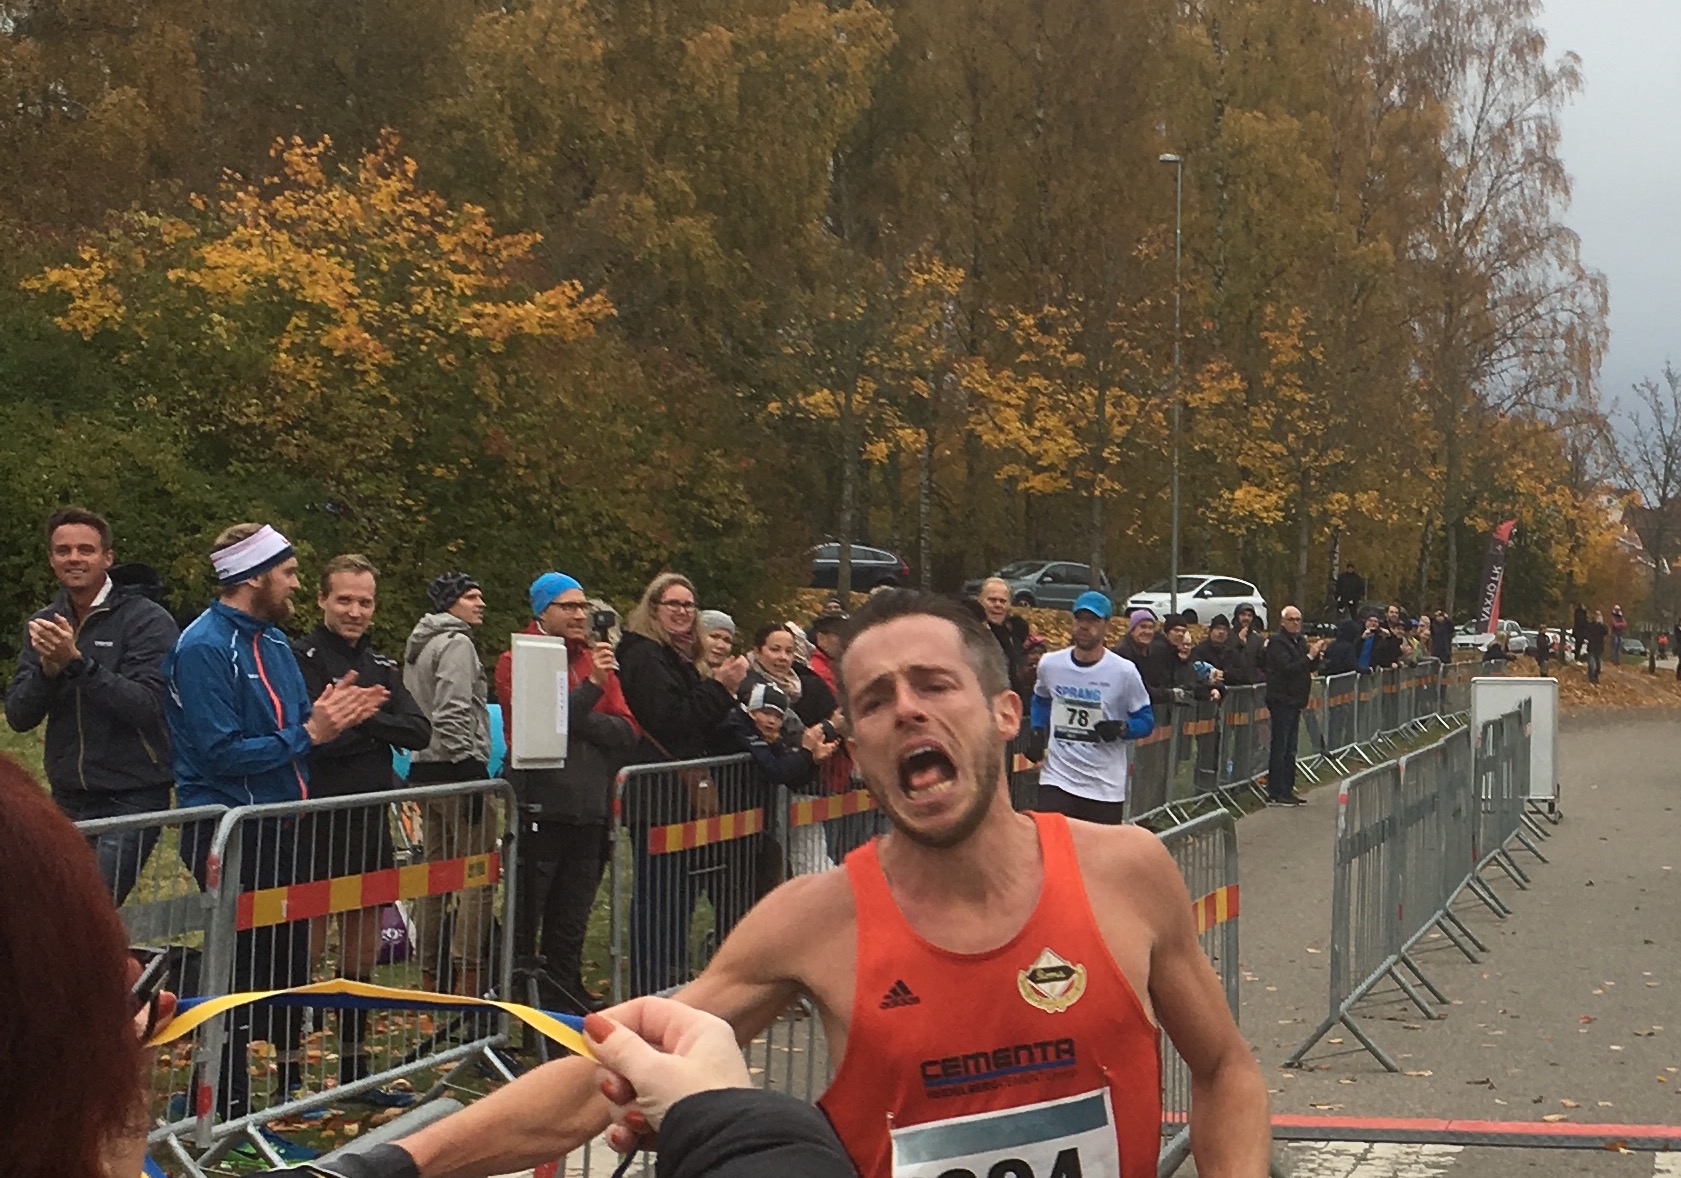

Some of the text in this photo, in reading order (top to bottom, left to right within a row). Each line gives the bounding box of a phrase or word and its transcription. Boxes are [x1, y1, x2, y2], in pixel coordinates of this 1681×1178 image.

[1490, 565, 1502, 581] LK
[1066, 707, 1090, 727] 78
[920, 1038, 1076, 1082] CEMENTA
